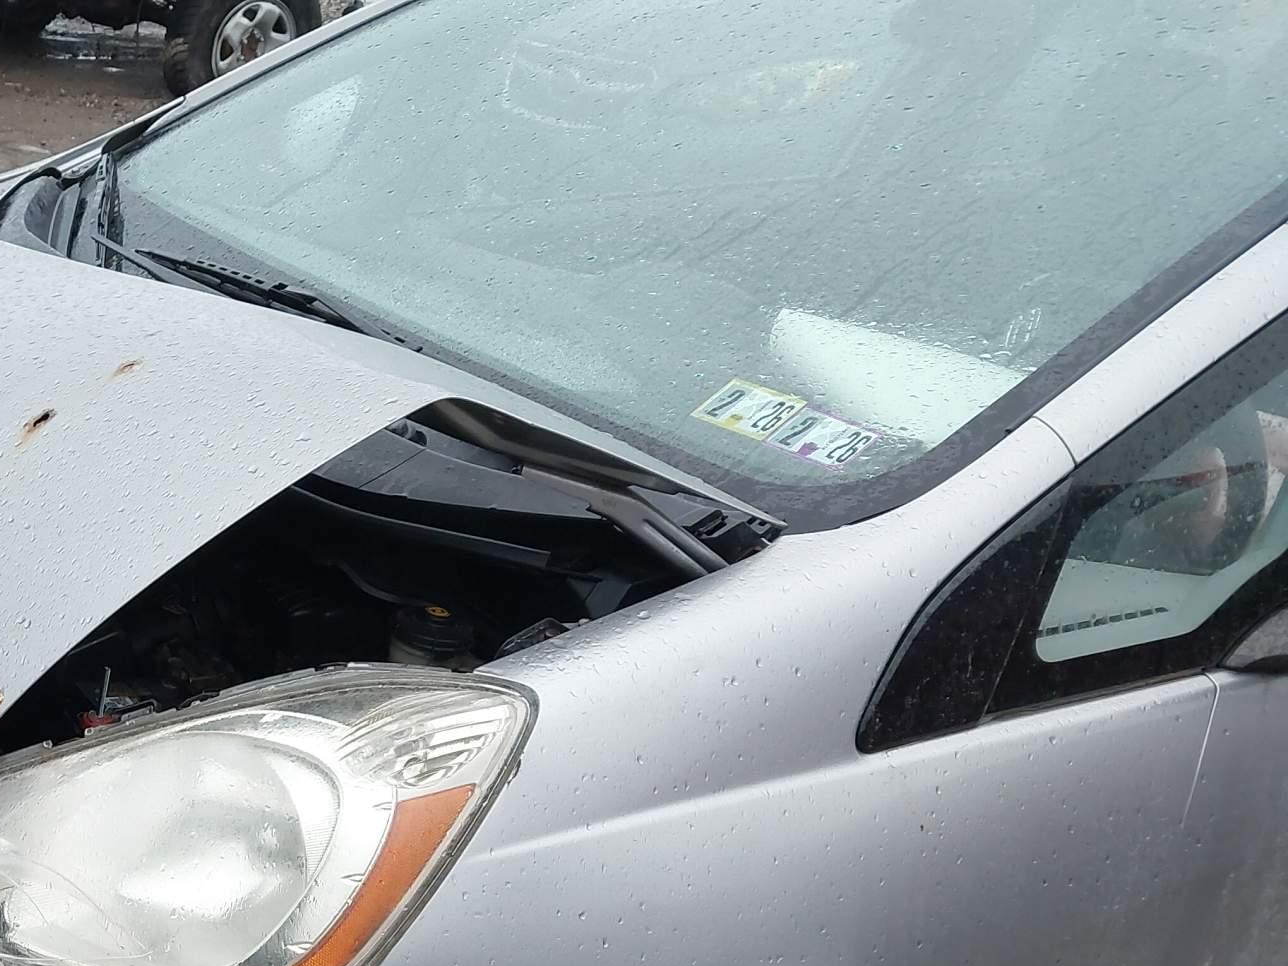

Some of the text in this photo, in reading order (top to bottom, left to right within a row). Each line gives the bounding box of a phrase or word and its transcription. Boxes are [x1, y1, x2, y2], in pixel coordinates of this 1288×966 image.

[707, 389, 746, 417] 2
[750, 401, 795, 432] 26
[778, 416, 819, 447] 2
[824, 431, 873, 464] 26
